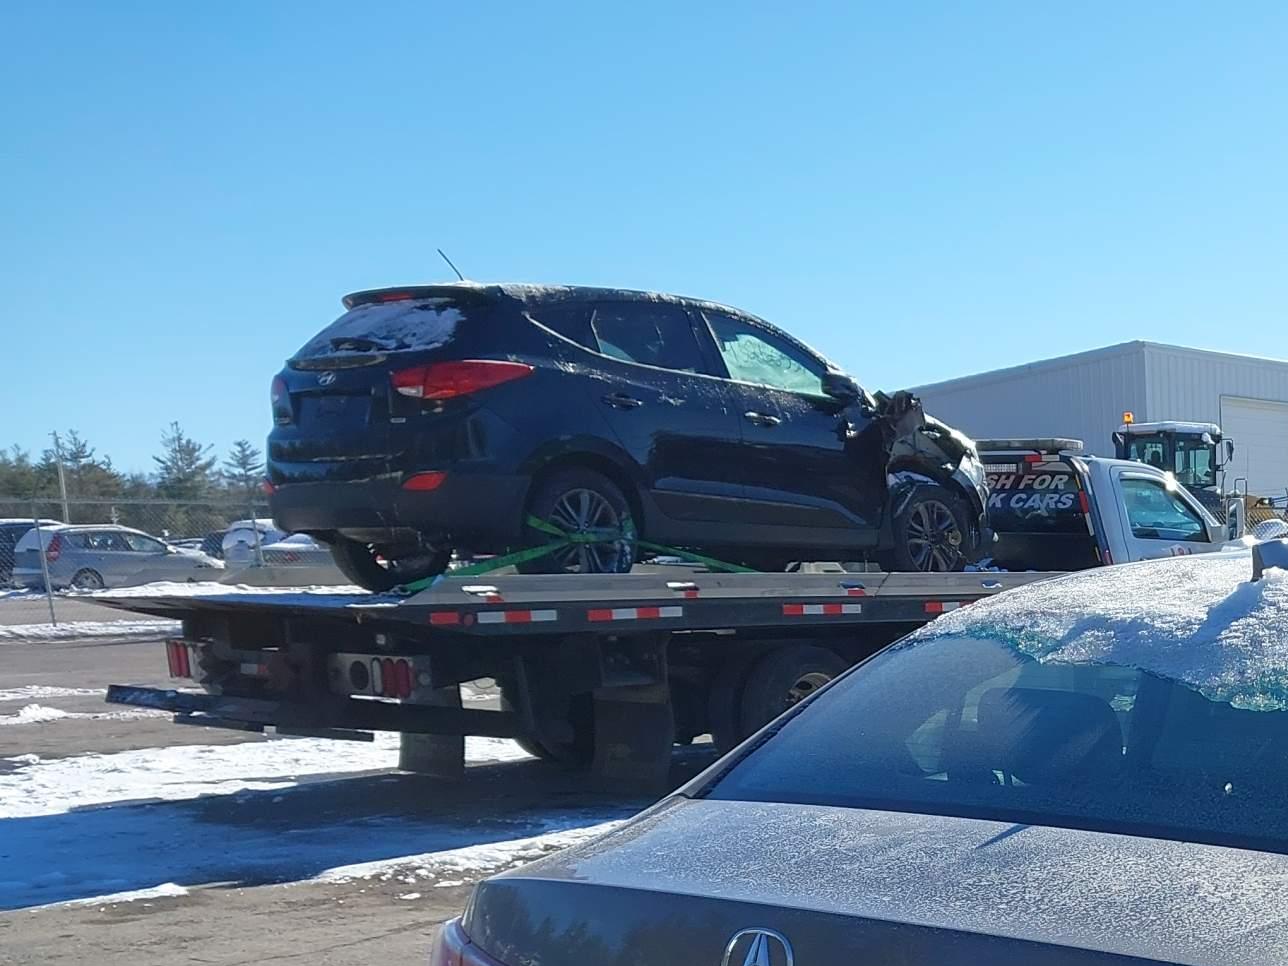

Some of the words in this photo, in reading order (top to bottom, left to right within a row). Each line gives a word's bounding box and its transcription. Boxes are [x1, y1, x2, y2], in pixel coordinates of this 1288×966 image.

[987, 474, 1016, 490] SH
[1018, 474, 1069, 490] FOR
[1010, 493, 1075, 509] CARS
